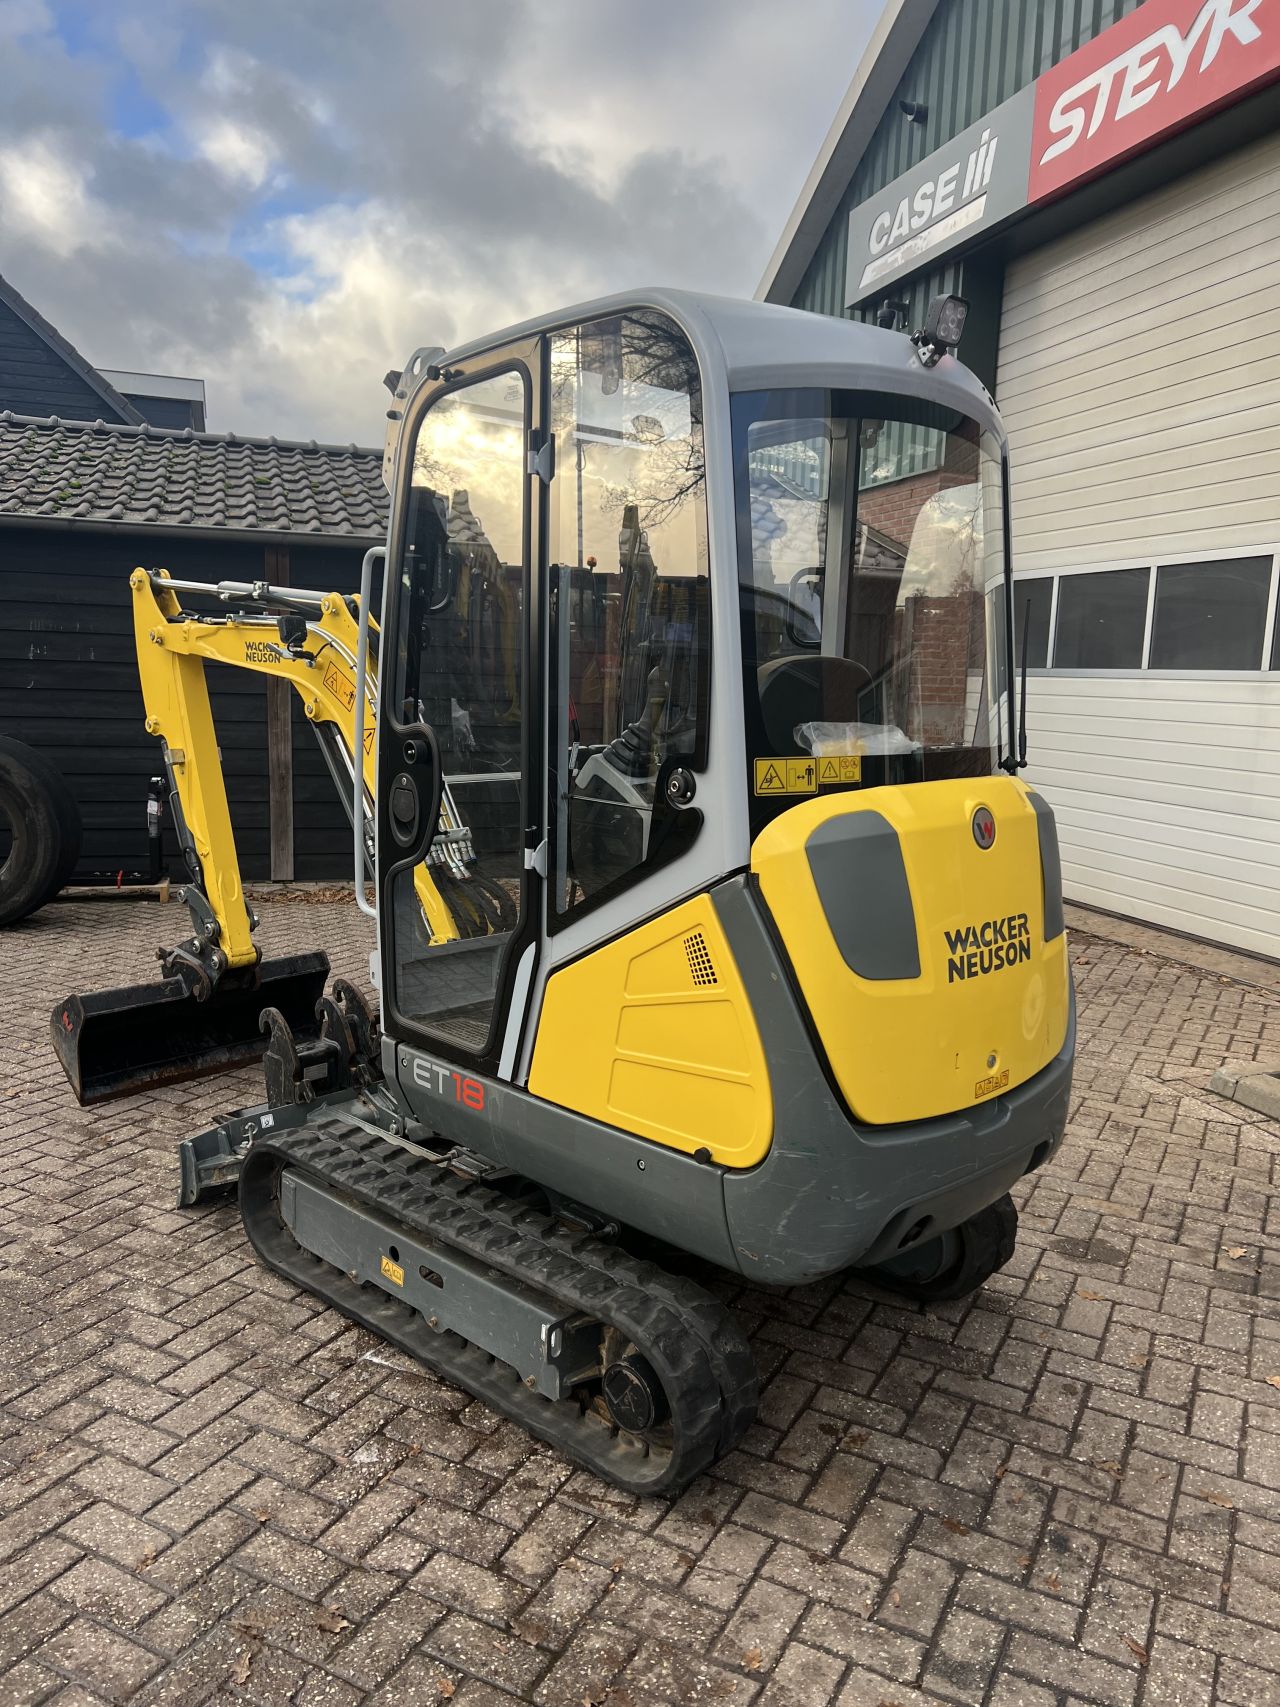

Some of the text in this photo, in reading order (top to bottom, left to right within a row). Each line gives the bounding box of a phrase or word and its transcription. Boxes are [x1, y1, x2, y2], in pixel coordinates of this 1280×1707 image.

[1039, 0, 1263, 166] STEYR
[869, 162, 961, 255] CASE
[245, 651, 281, 664] NEUSON
[943, 912, 1030, 956] WACKER
[947, 936, 1031, 984] NEUSON
[413, 1058, 485, 1111] ET18
